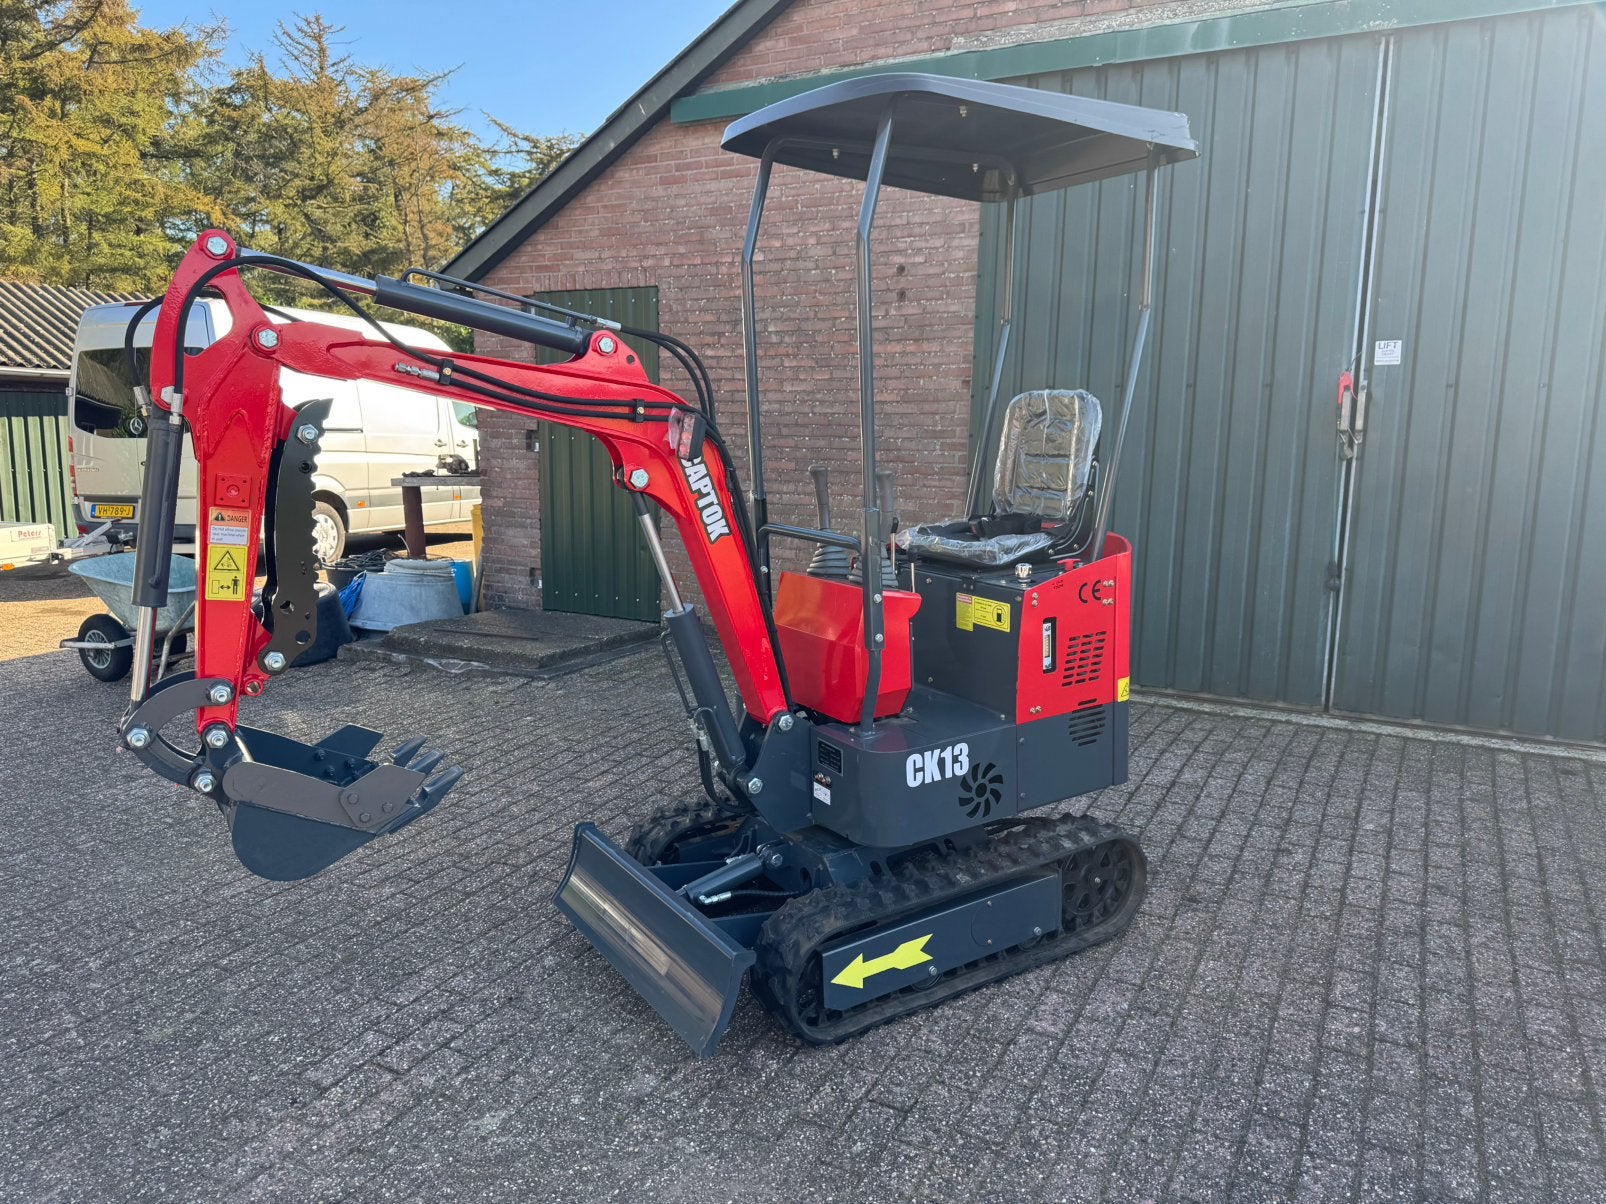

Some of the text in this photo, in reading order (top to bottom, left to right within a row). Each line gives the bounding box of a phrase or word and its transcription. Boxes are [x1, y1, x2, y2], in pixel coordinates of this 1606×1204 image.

[1378, 342, 1398, 350] LIFT
[226, 514, 248, 523] DANGER
[906, 742, 969, 788] CK13
